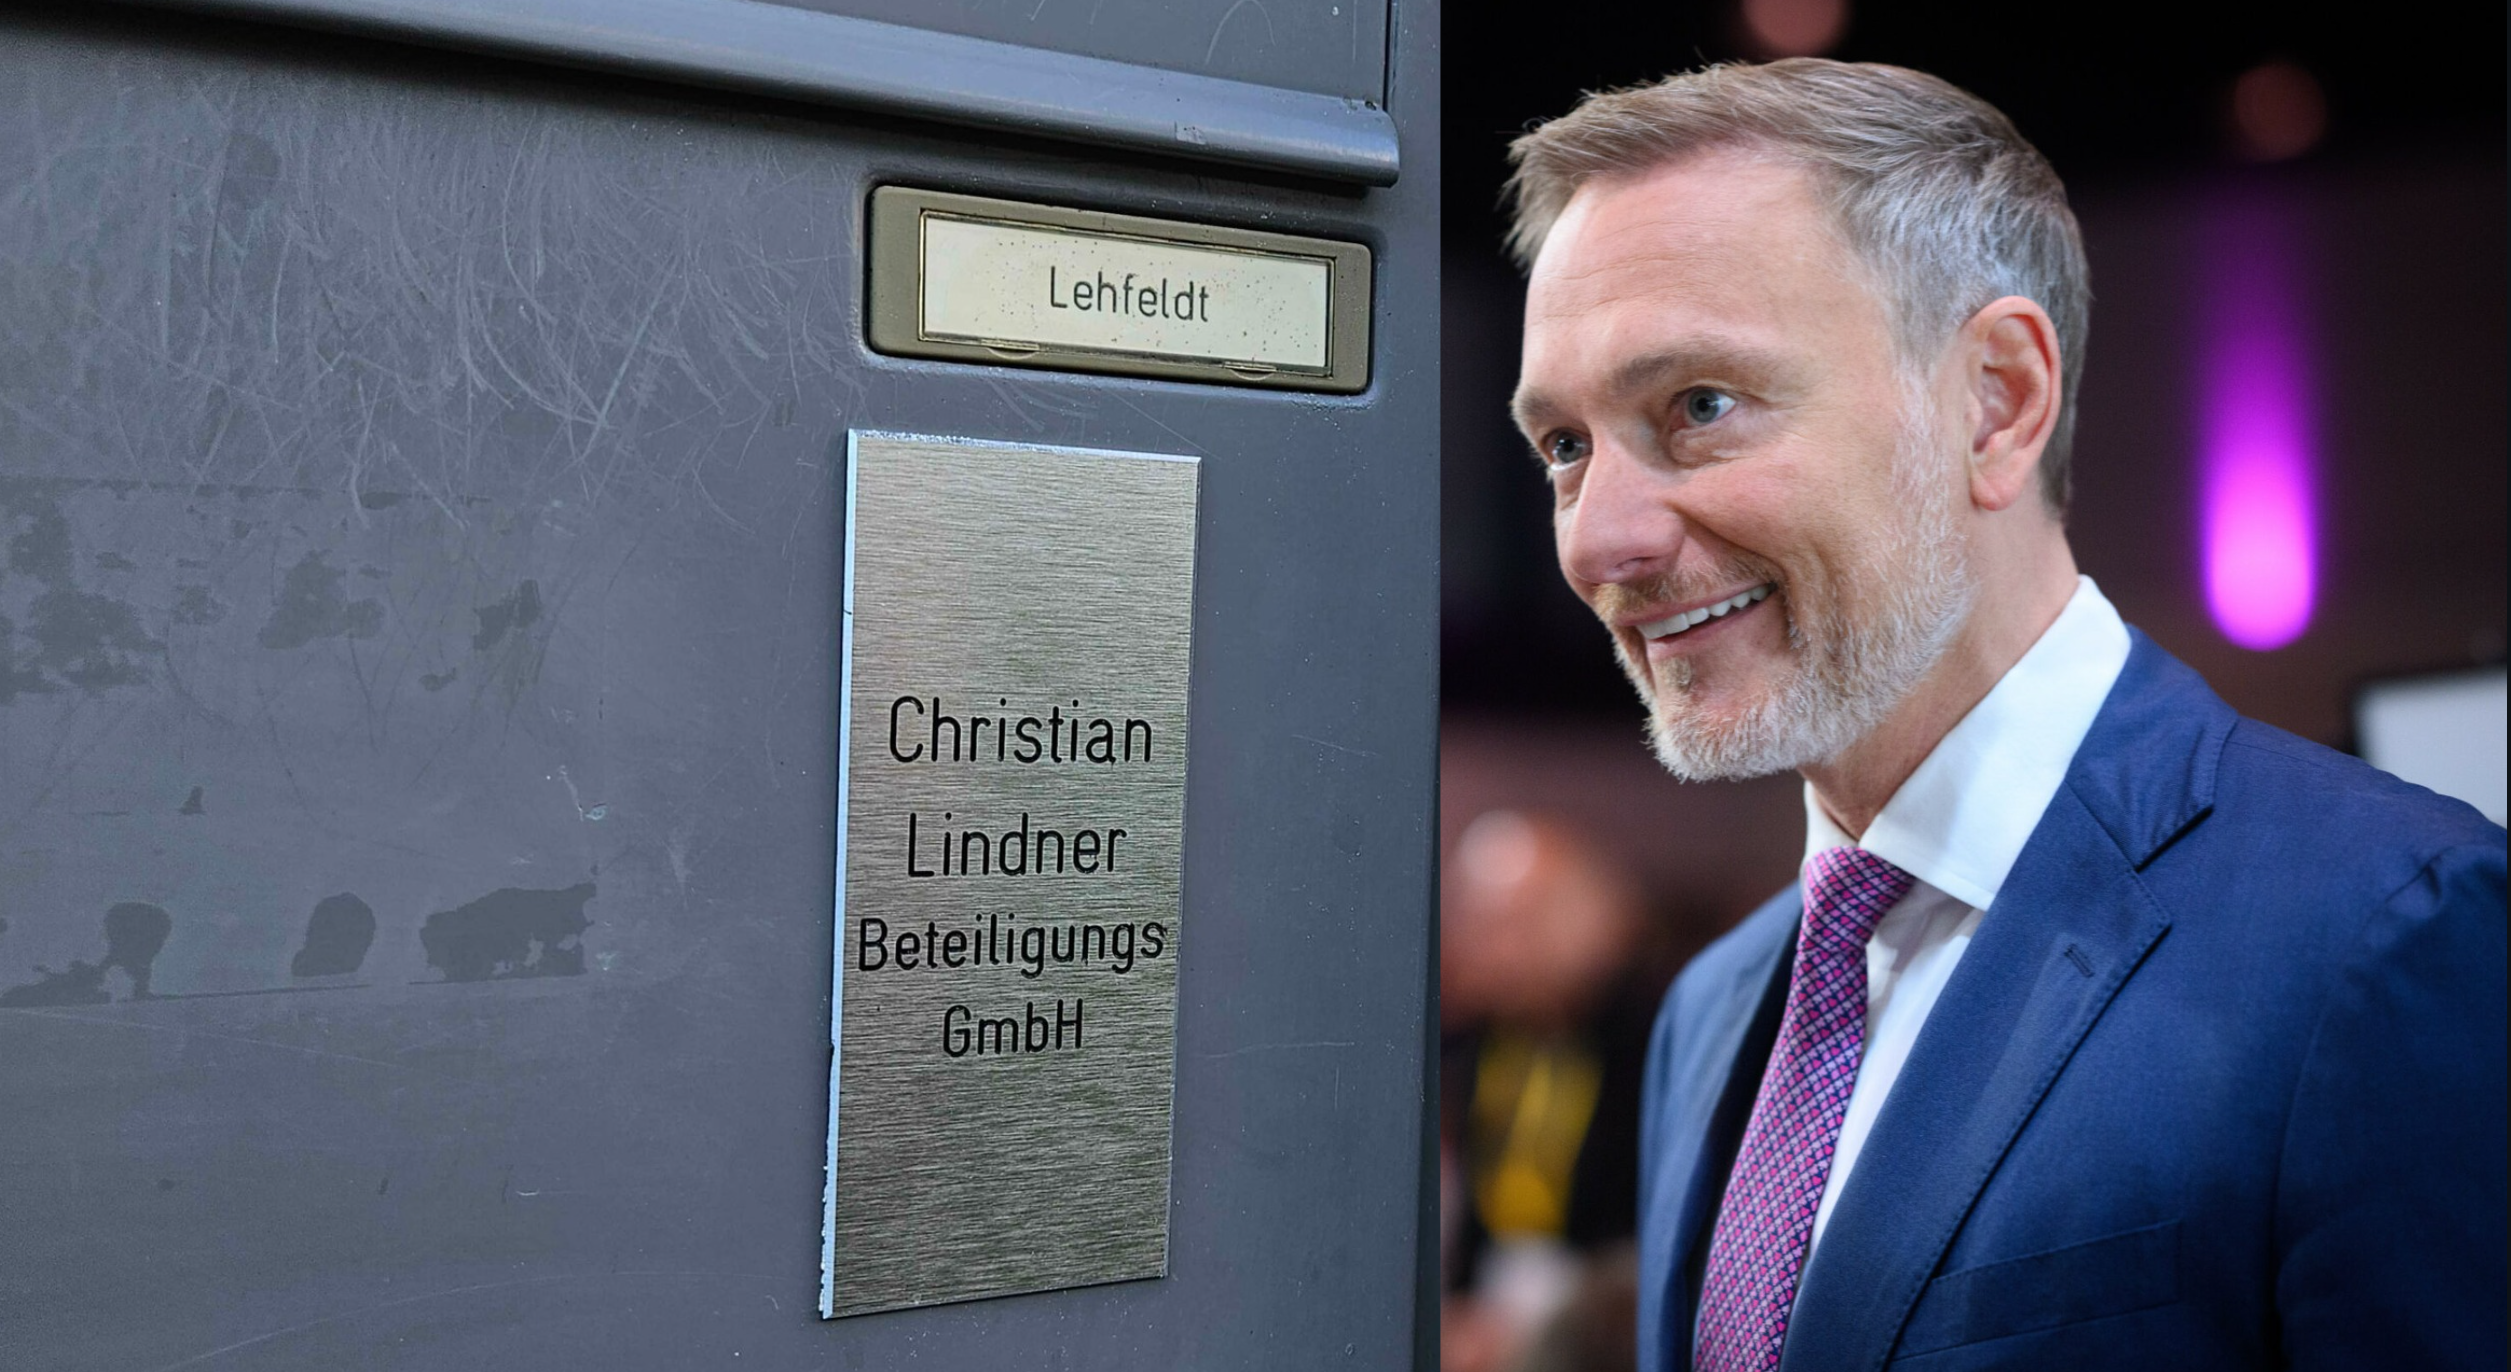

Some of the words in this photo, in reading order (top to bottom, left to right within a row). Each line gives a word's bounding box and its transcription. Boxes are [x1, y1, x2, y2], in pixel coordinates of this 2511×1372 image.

[1050, 265, 1211, 324] Lehfeldt
[888, 695, 1153, 765] Christian
[906, 811, 1128, 878] Lindner
[858, 913, 1168, 980] Beteiligungs
[942, 997, 1084, 1059] GmbH
